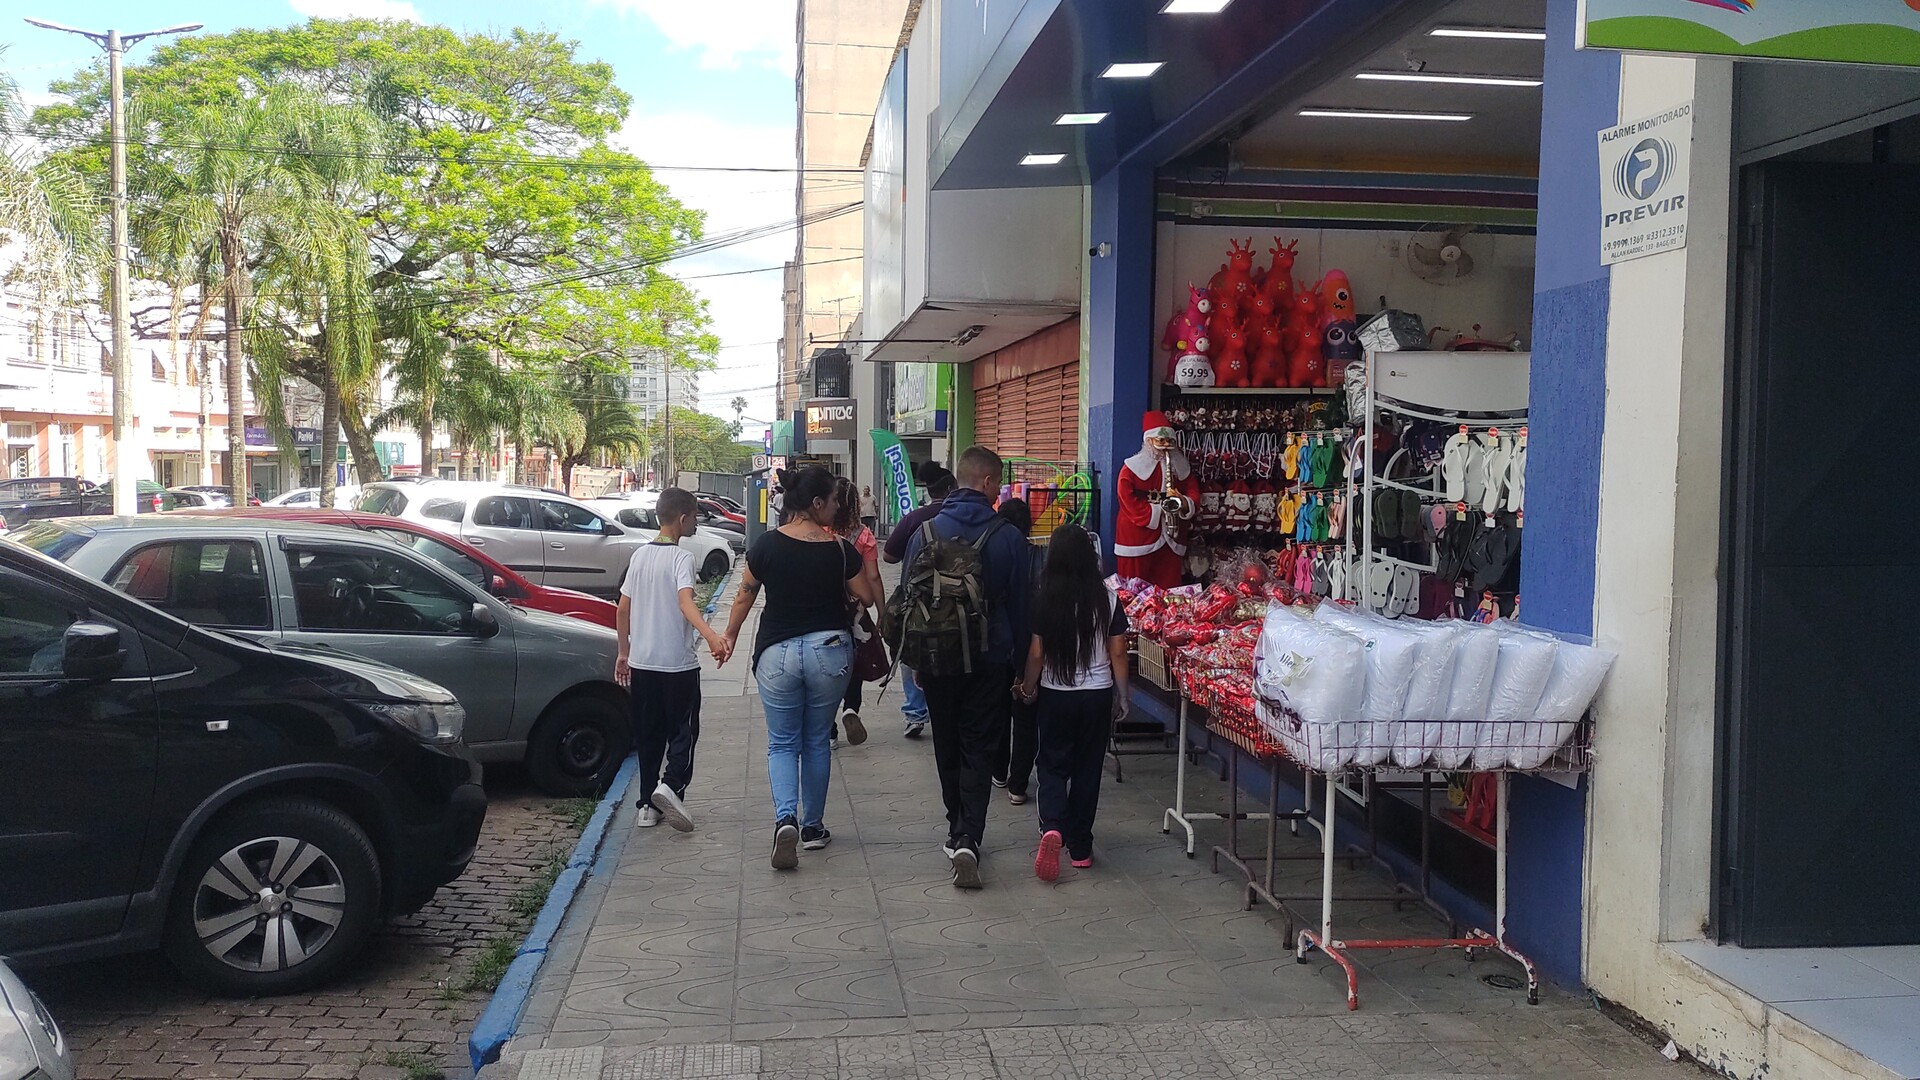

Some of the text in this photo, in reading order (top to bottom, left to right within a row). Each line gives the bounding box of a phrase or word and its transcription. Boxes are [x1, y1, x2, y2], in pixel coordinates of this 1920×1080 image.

[1601, 105, 1690, 144] ALARME MONITORADO
[1604, 195, 1685, 228] PREVIR
[1181, 368, 1209, 380] 59,99
[757, 458, 762, 466] E
[755, 479, 762, 487] P
